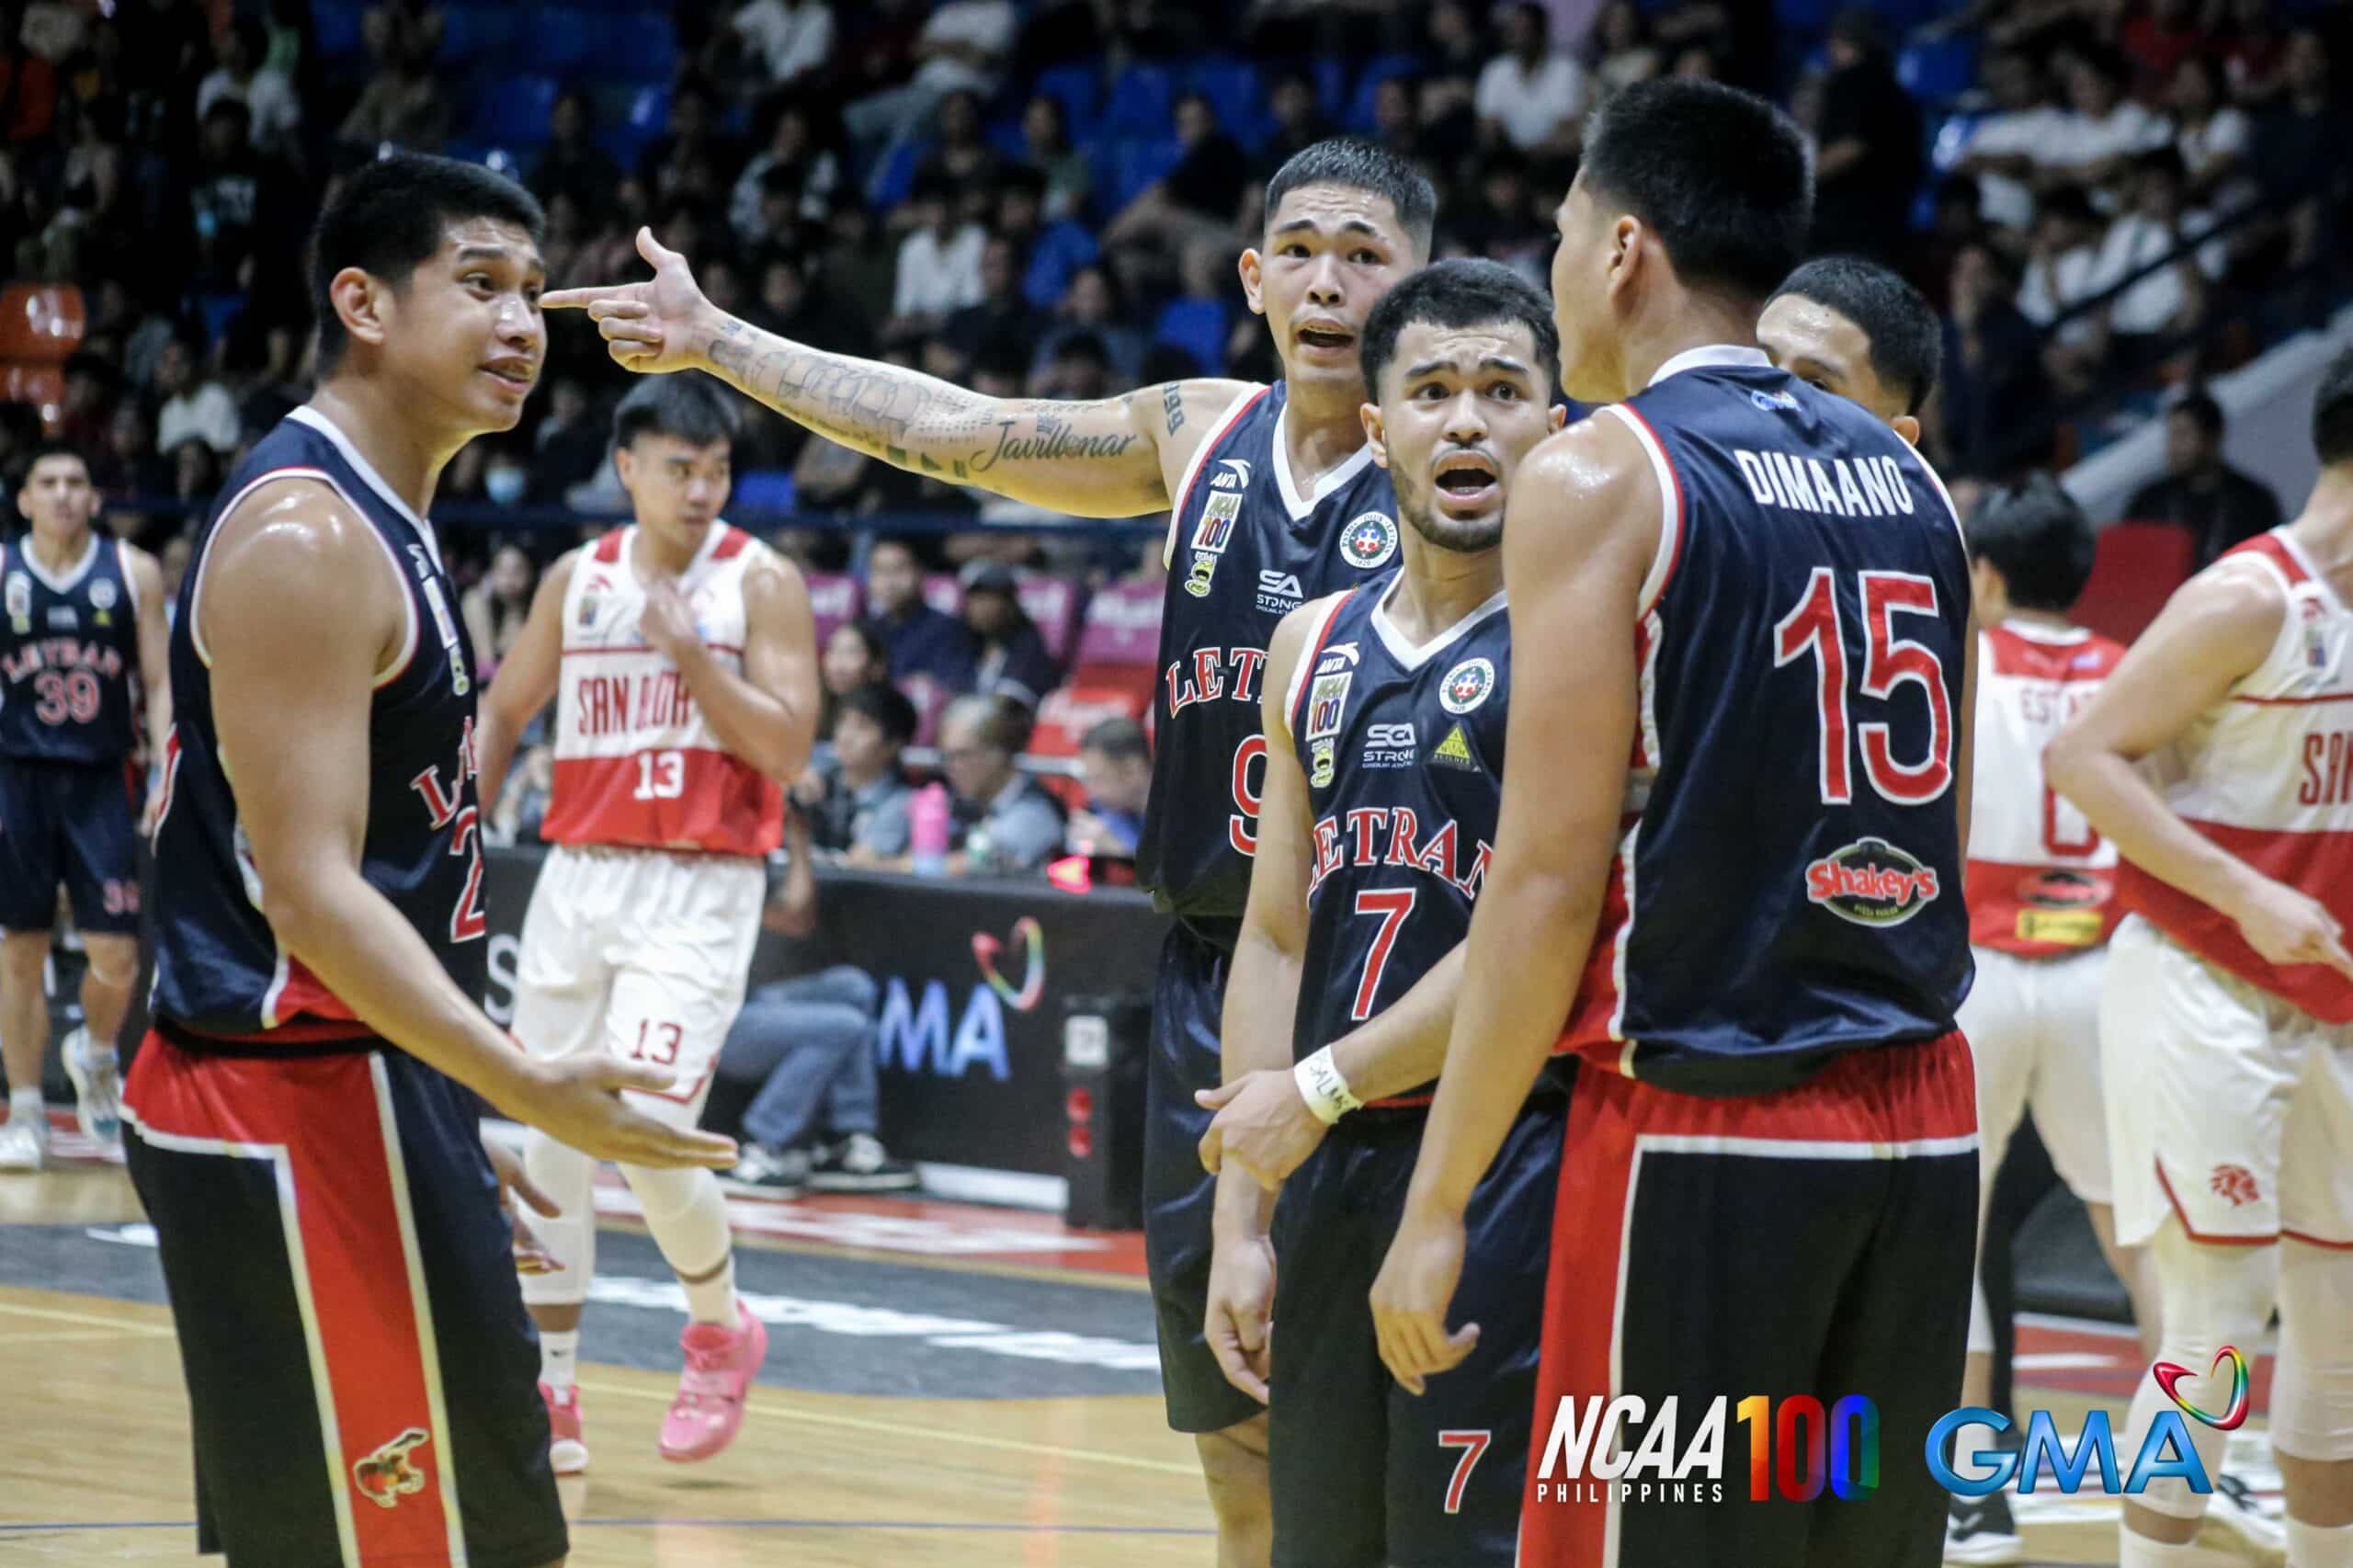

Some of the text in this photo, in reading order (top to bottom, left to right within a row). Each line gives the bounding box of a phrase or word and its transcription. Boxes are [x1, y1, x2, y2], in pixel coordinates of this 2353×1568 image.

[1733, 449, 1915, 517] DIMAANO
[1198, 517, 1230, 548] 100
[2, 638, 121, 683] LETRAN
[1165, 647, 1267, 719] LET
[1774, 567, 1952, 805] 15
[34, 670, 98, 724] 39
[578, 676, 629, 734] SAN
[1312, 699, 1341, 733] 100
[633, 749, 685, 801] 13
[1805, 859, 1939, 906] Shakey's
[1352, 888, 1417, 1021] 7
[631, 1018, 683, 1066] 13
[880, 976, 1011, 1081] MA
[1438, 1429, 1491, 1514] 7
